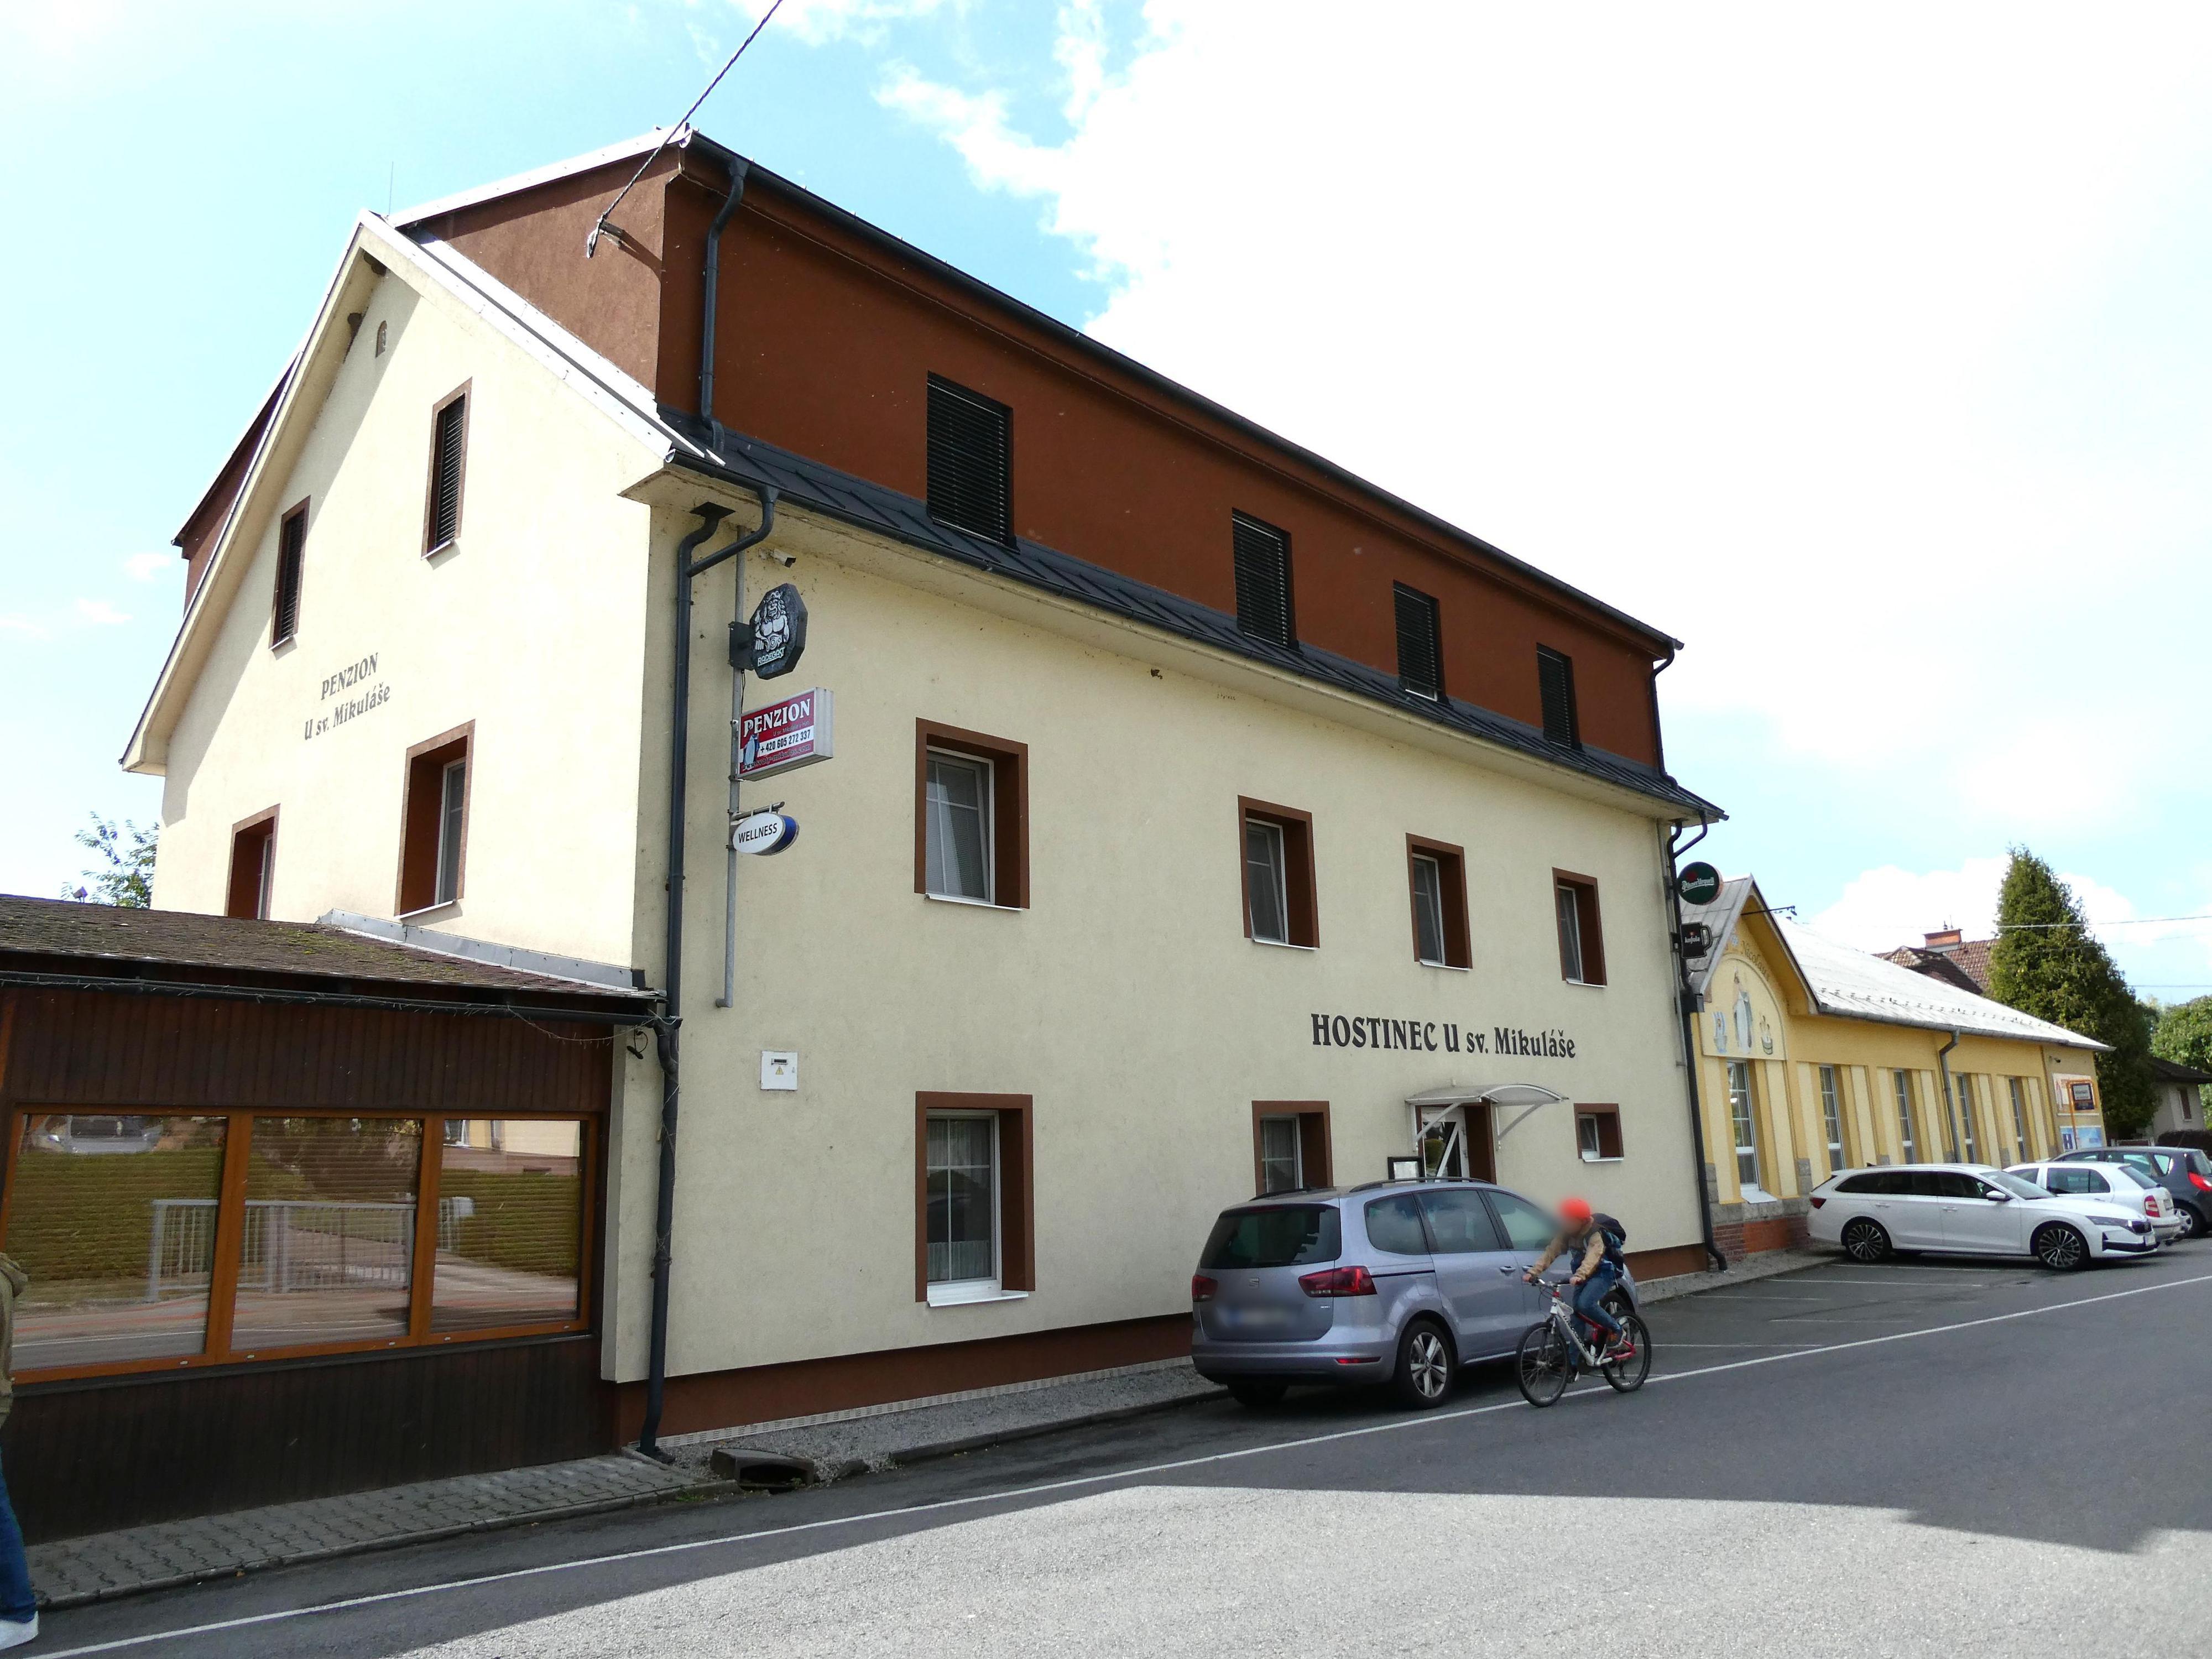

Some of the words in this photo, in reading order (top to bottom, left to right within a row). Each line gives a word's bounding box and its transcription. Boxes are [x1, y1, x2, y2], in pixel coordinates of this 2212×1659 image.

[757, 647, 786, 665] RADEGAST
[321, 652, 378, 701] PENZION
[305, 719, 313, 740] U
[316, 717, 329, 736] sv.
[333, 681, 390, 728] Mikuláše
[743, 698, 811, 738] PENZION
[760, 740, 776, 753] +420
[777, 738, 787, 748] 605
[789, 734, 799, 745] 272
[800, 729, 811, 742] 337
[738, 823, 778, 843] WELLNESS
[1311, 1013, 1438, 1052] HOSTINEC
[1443, 1024, 1460, 1052] U
[1466, 1032, 1489, 1054] sv.
[1494, 1027, 1576, 1058] Mikuláše
